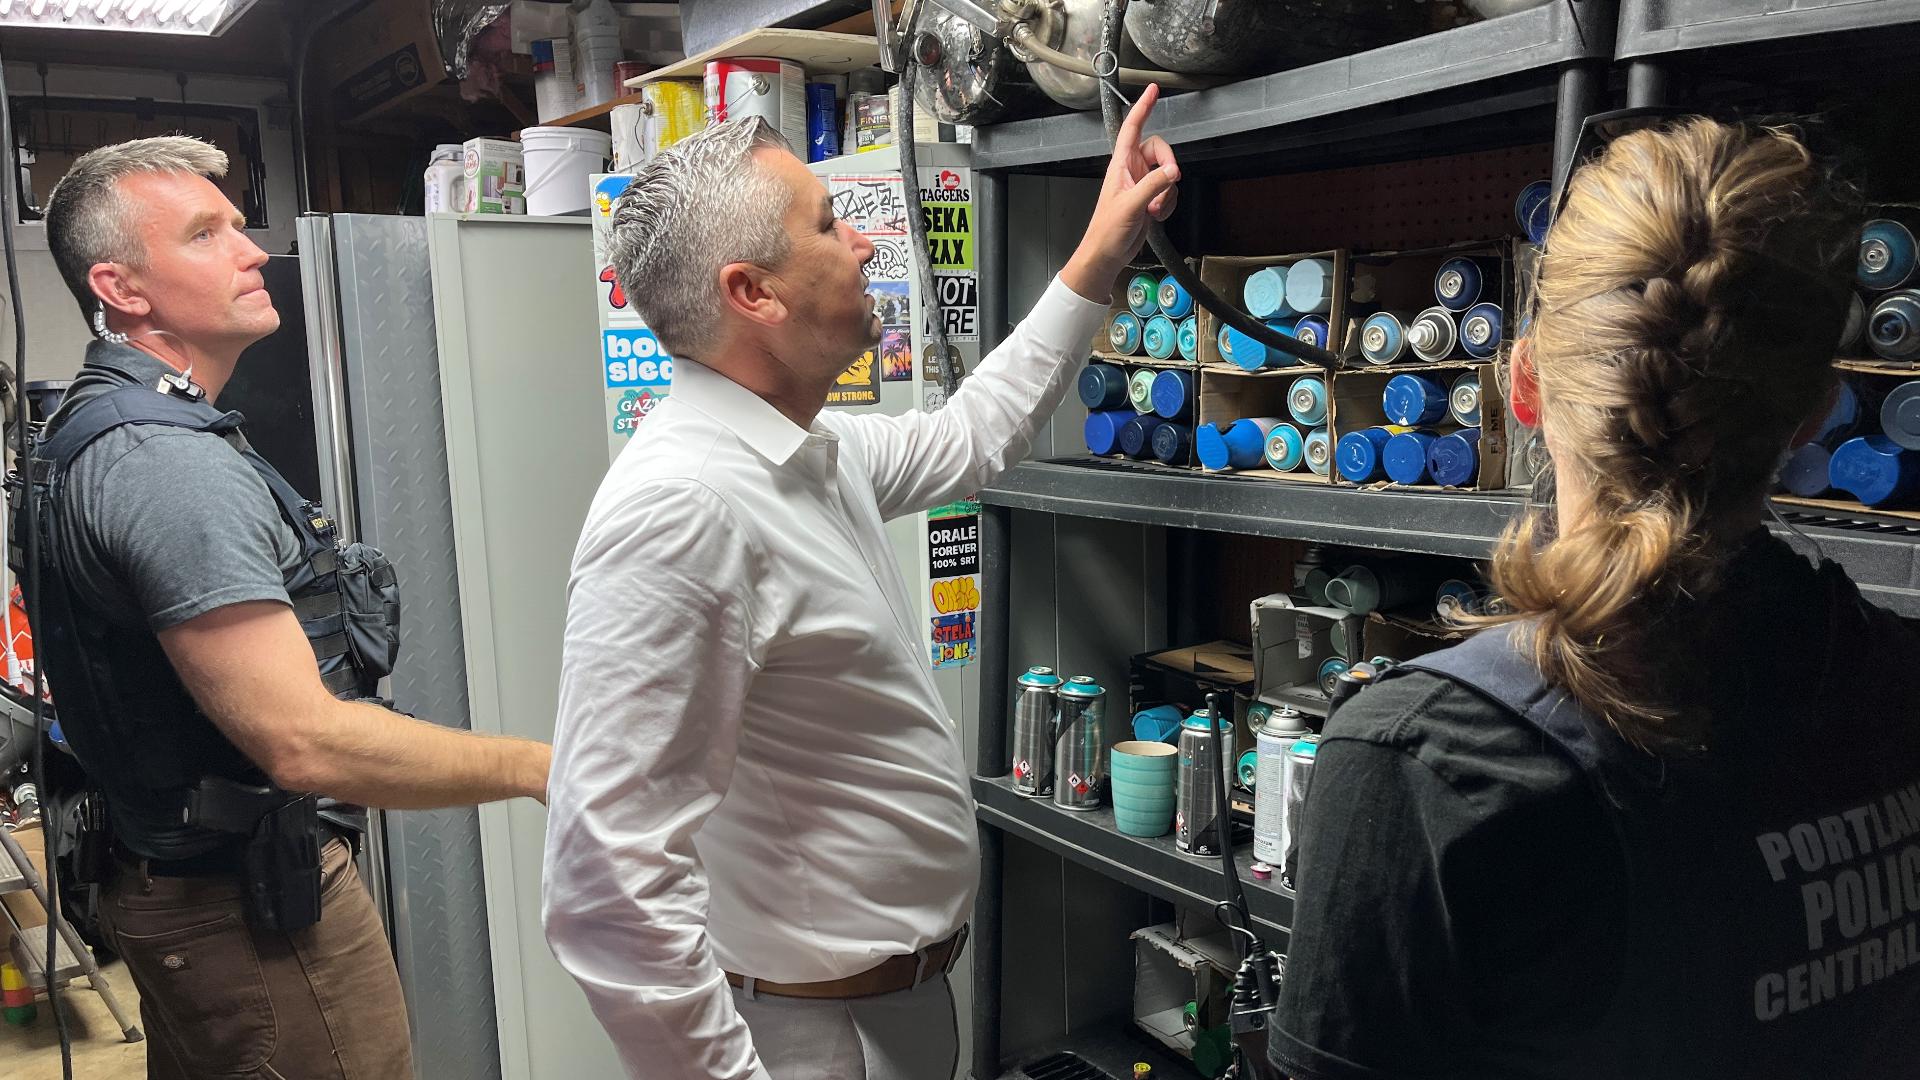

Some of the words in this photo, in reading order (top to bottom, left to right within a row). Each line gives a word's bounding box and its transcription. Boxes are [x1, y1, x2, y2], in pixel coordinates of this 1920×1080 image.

[935, 174, 940, 187] i
[920, 188, 970, 201] TAGGERS
[922, 207, 969, 232] SEKA
[842, 391, 875, 401] STRONG.
[930, 526, 977, 544] ORALE
[932, 543, 977, 558] FOREVER
[932, 559, 957, 569] 100%
[960, 556, 976, 566] SRT
[934, 622, 972, 643] STELA
